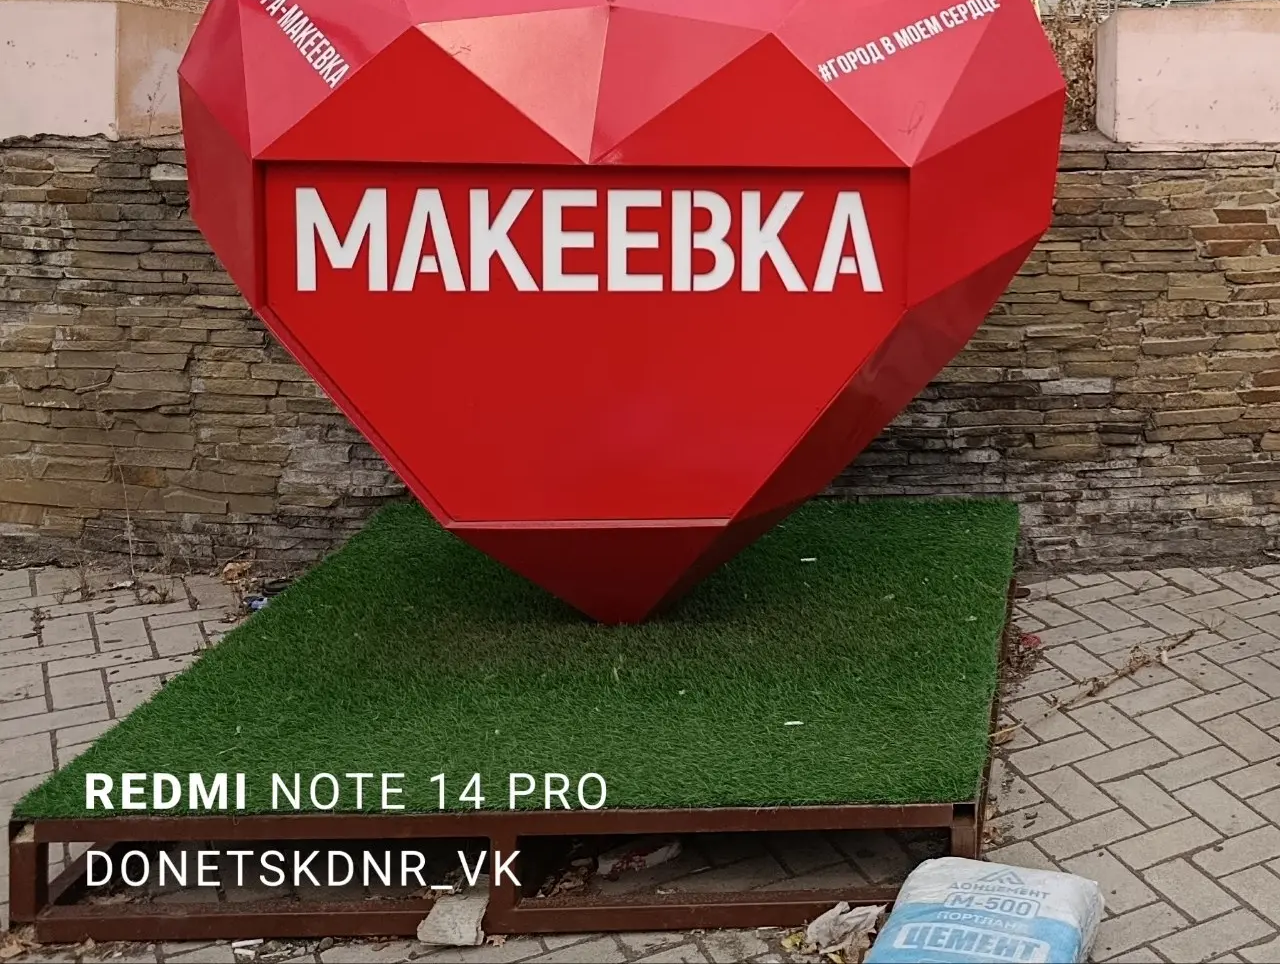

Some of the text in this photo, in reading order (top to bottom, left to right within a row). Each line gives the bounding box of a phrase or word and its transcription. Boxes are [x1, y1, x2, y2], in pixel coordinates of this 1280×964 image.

[818, 41, 885, 83] #ГОРОД
[879, 35, 897, 55] В
[893, 15, 944, 49] МОЕМ
[294, 187, 885, 293] МАКЕЕВКА
[946, 882, 1052, 900] ДОНЦЕМЕНТ
[949, 894, 1032, 916] М-500
[902, 925, 1041, 960] ЦЕМЕНТ
